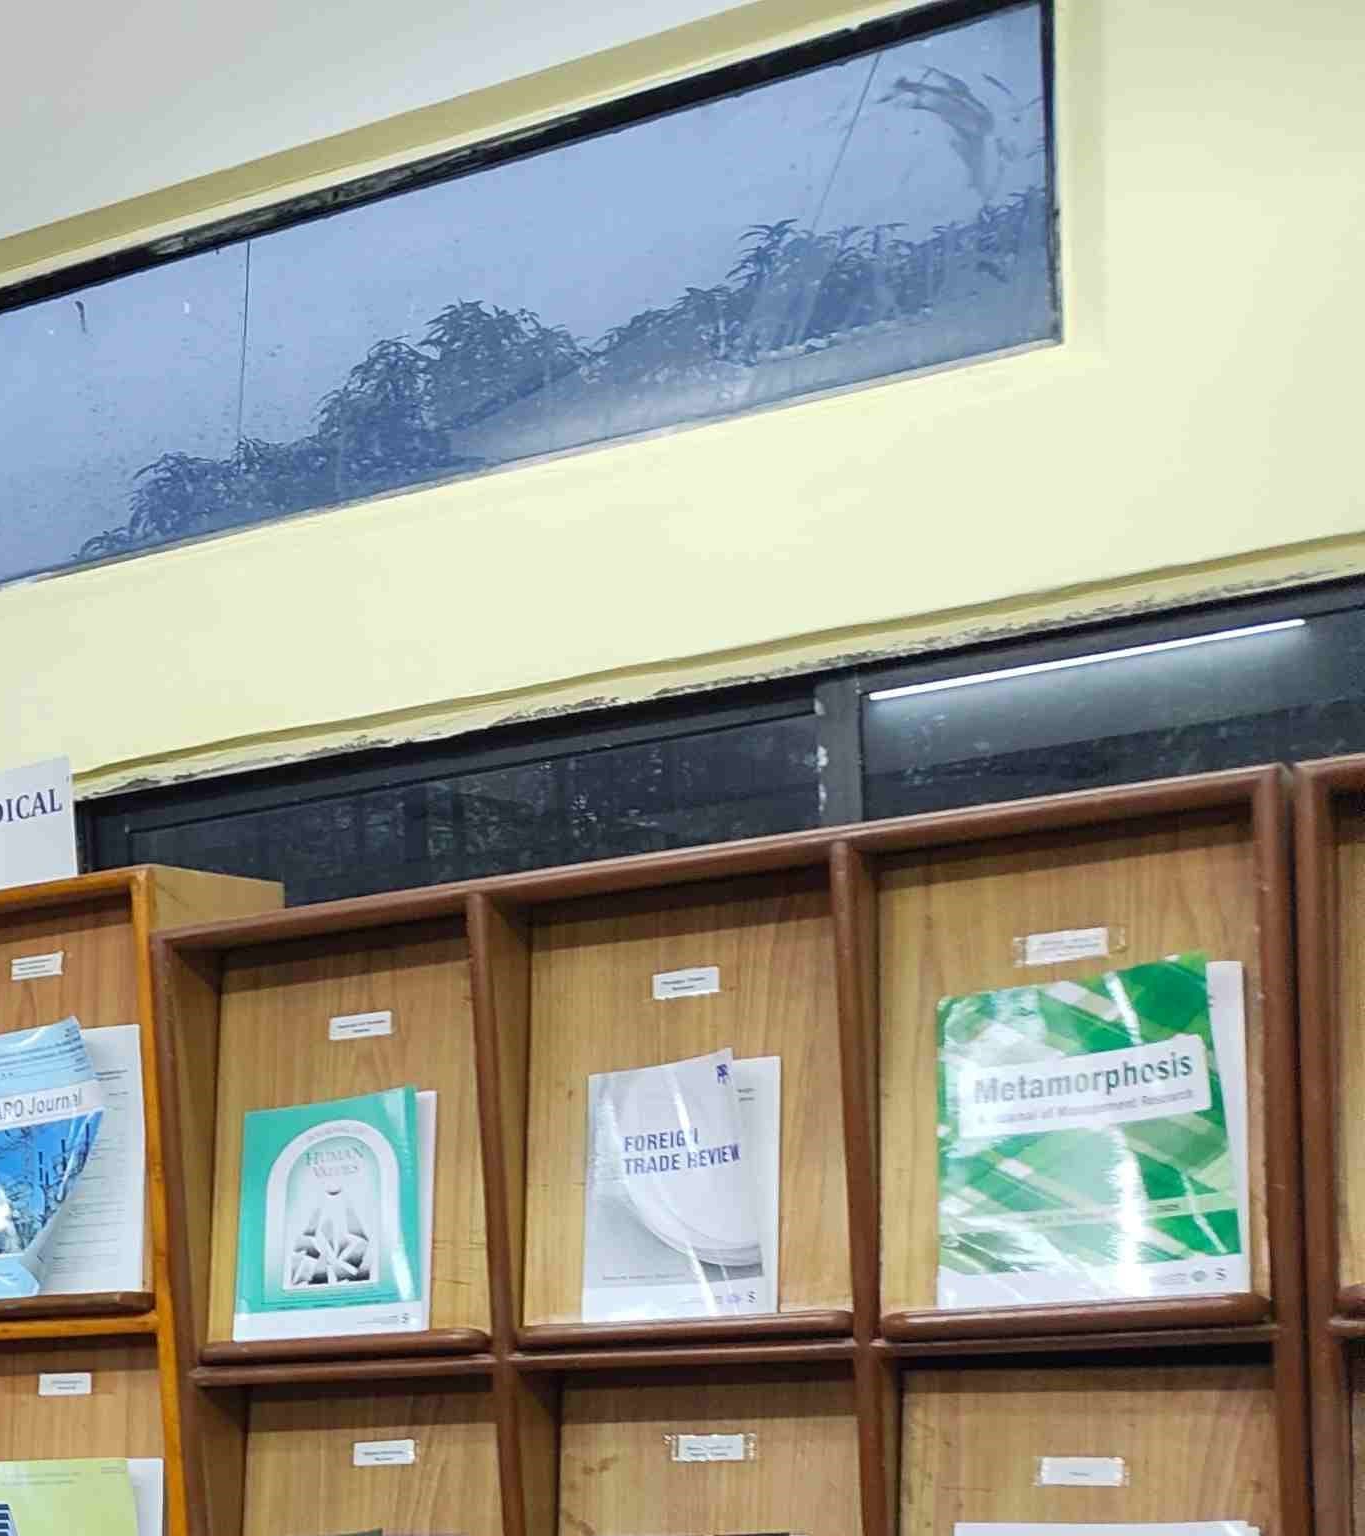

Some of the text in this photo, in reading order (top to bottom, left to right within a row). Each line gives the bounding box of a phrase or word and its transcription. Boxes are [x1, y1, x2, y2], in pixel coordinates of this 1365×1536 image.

[973, 1052, 1193, 1104] Metamorphosis
[304, 1147, 364, 1166] HUMAN
[624, 1143, 741, 1174] TRADE REVIEW
